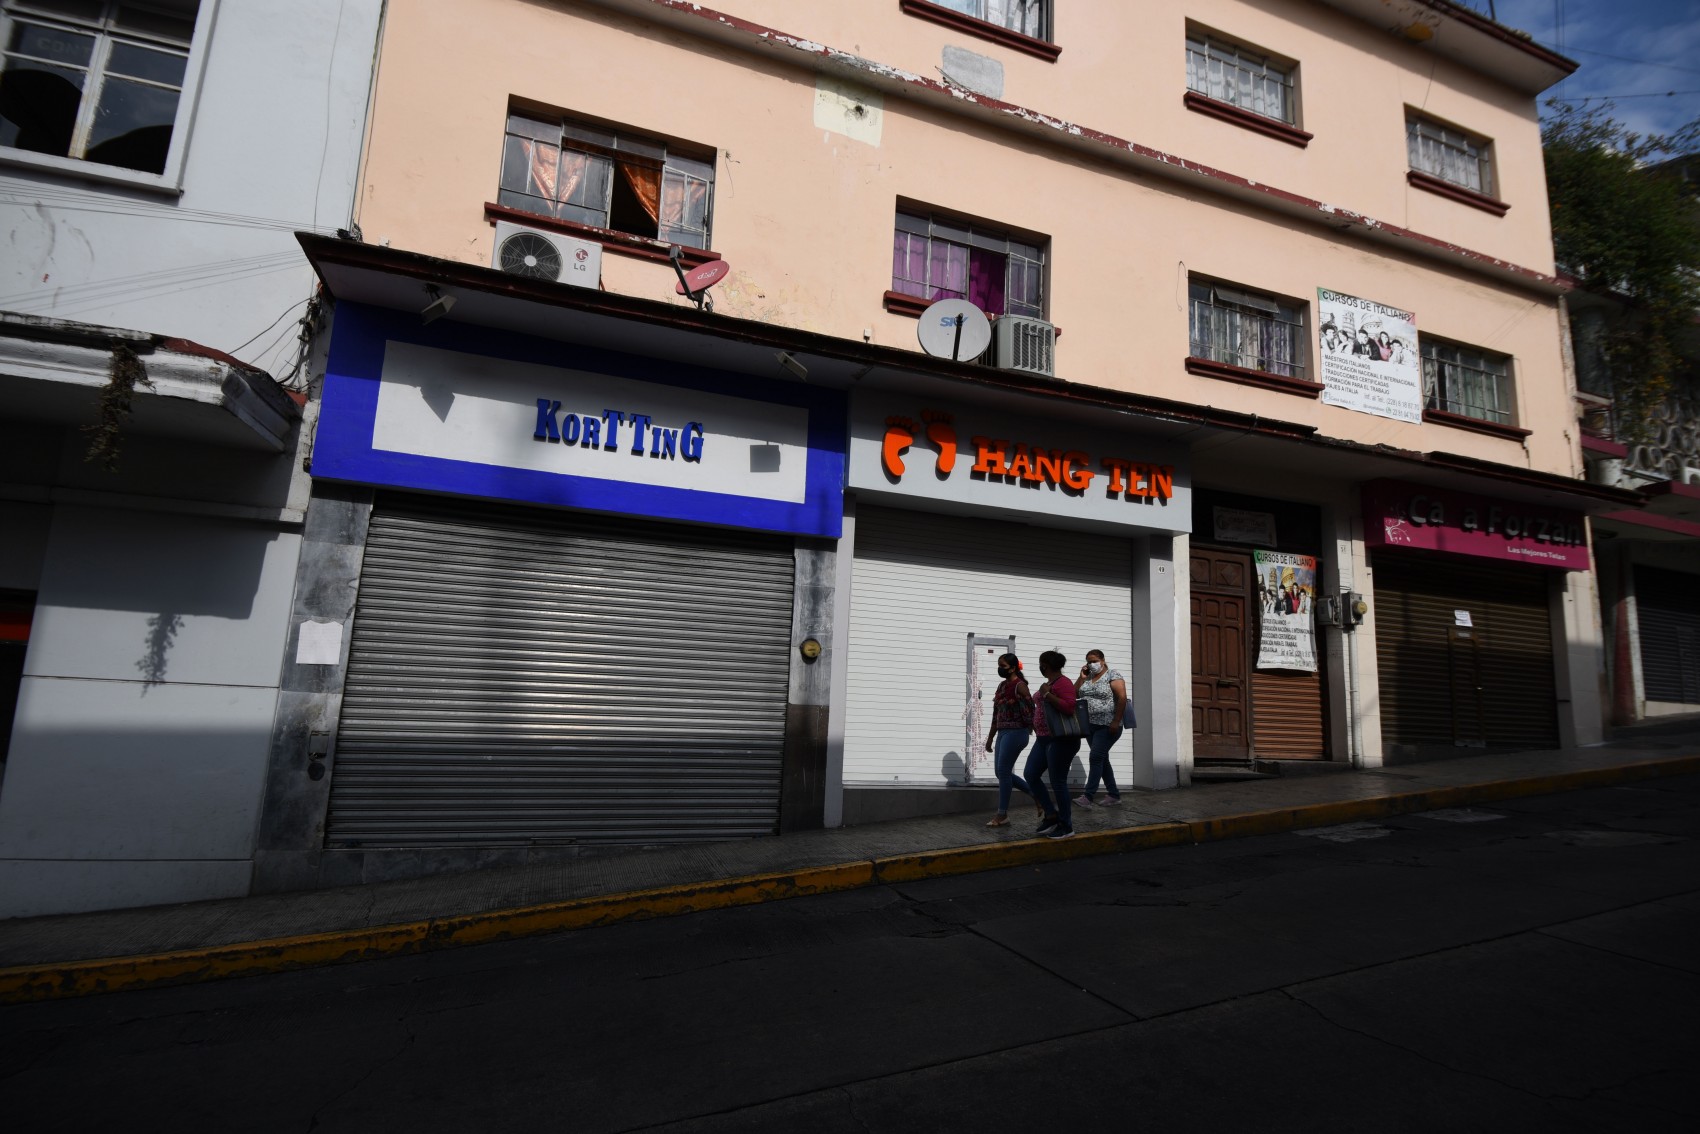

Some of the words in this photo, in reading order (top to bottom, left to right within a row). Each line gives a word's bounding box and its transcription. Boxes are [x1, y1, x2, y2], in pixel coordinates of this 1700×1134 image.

[573, 262, 586, 272] LG
[1322, 290, 1359, 309] CURSOS
[1360, 300, 1372, 313] DE
[1373, 304, 1411, 322] ITALIANO
[1324, 354, 1349, 365] MAESTROS
[1348, 361, 1371, 371] ITALIANOS
[1325, 368, 1359, 381] TRADUCCIONES
[1357, 369, 1379, 379] NACIONAL
[1383, 375, 1416, 388] INTERNACIONAL
[1344, 387, 1359, 395] ITALIA
[1351, 381, 1363, 389] PARA
[1370, 386, 1390, 395] TRABAJO
[970, 435, 1095, 494] HANG
[1103, 457, 1175, 499] TEN
[1256, 551, 1279, 564] CURSOS
[1279, 555, 1288, 565] DE
[1288, 556, 1313, 567] ITALIANO
[1507, 545, 1521, 554] Las
[1521, 547, 1548, 558] Mejores
[1548, 551, 1567, 561] Telas
